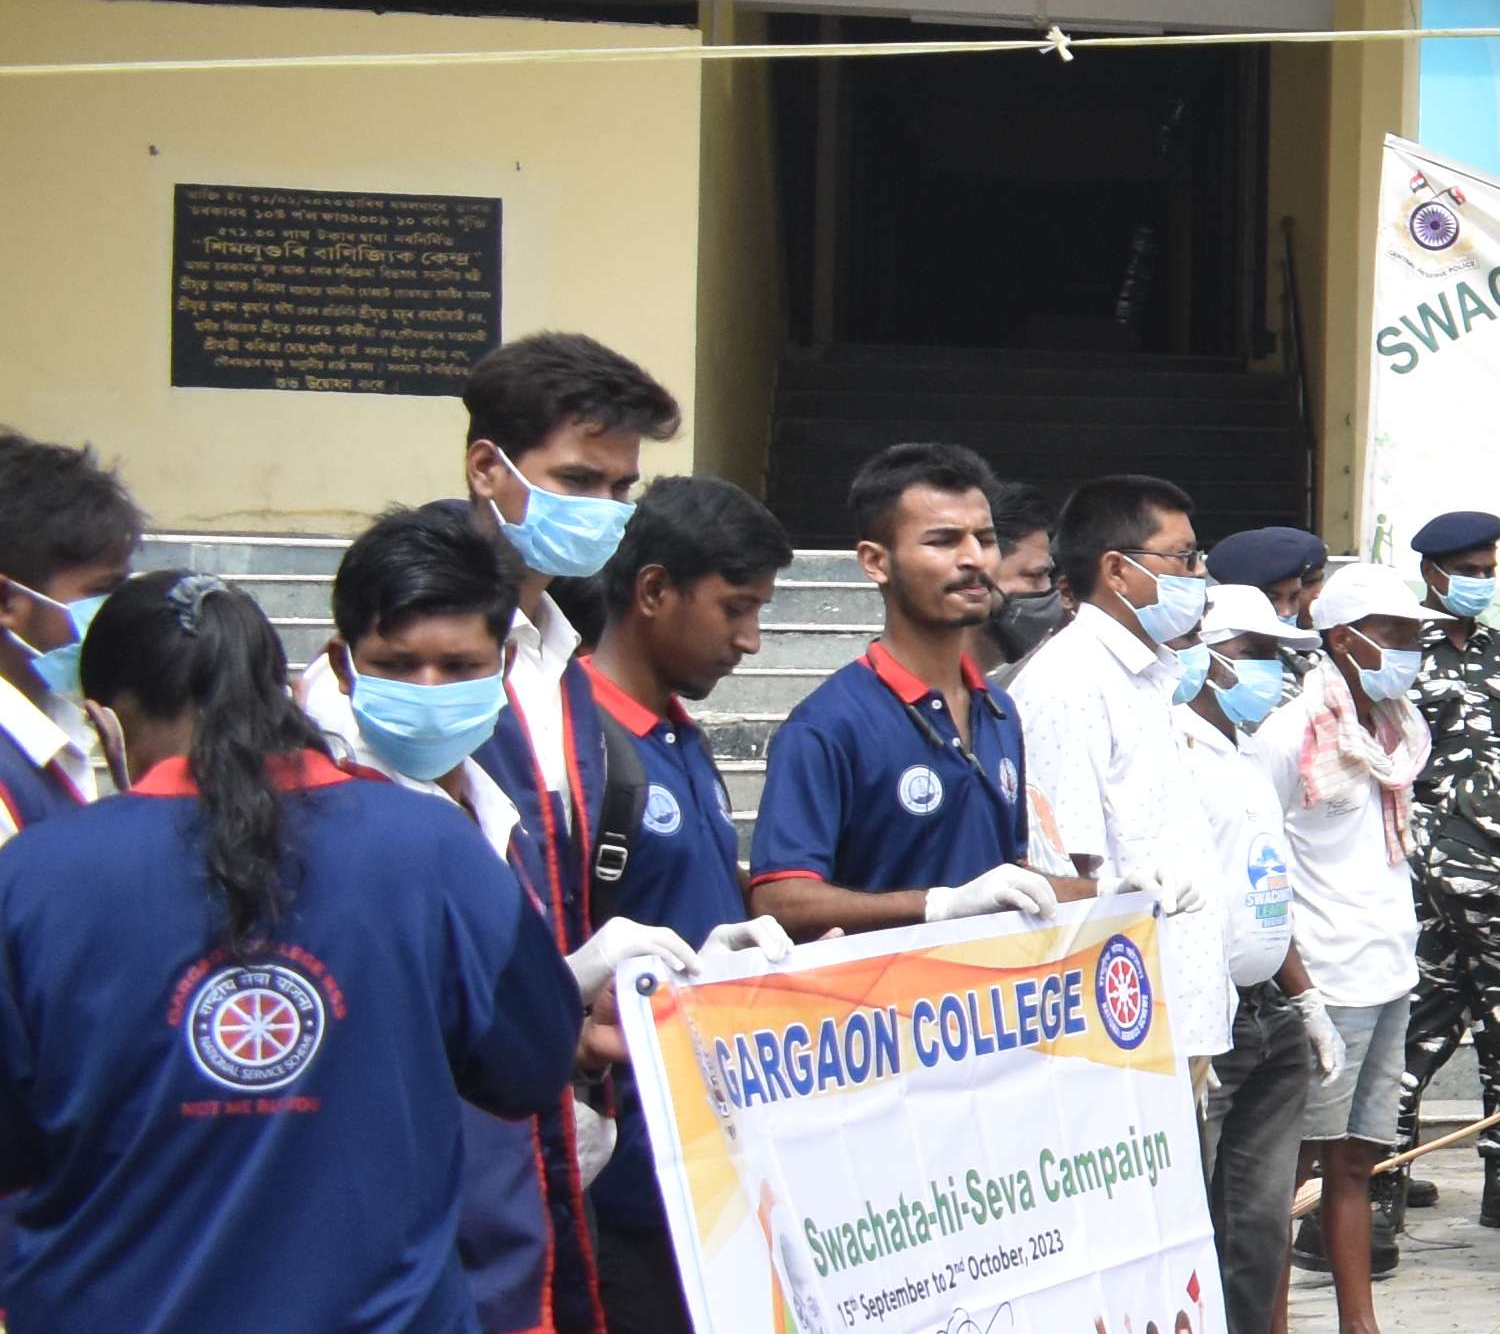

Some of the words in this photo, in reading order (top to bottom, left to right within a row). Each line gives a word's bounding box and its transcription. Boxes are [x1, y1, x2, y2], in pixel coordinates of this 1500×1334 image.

[1448, 258, 1478, 274] POLICE
[201, 1035, 239, 1079] NATIONAL
[241, 1066, 287, 1080] SERVICE
[285, 1034, 314, 1070] SCHEME
[714, 1004, 900, 1110] GARGAON
[912, 969, 1088, 1070] COLLEGE
[803, 1165, 1037, 1279] Swachata-hi-Seva
[1038, 1125, 1173, 1202] Campaign
[836, 1292, 860, 1328] 15th
[859, 1281, 932, 1324] September
[932, 1272, 948, 1295] to
[947, 1259, 966, 1290] 2nd
[967, 1242, 1030, 1282] October,
[1031, 1228, 1065, 1262] 2023
